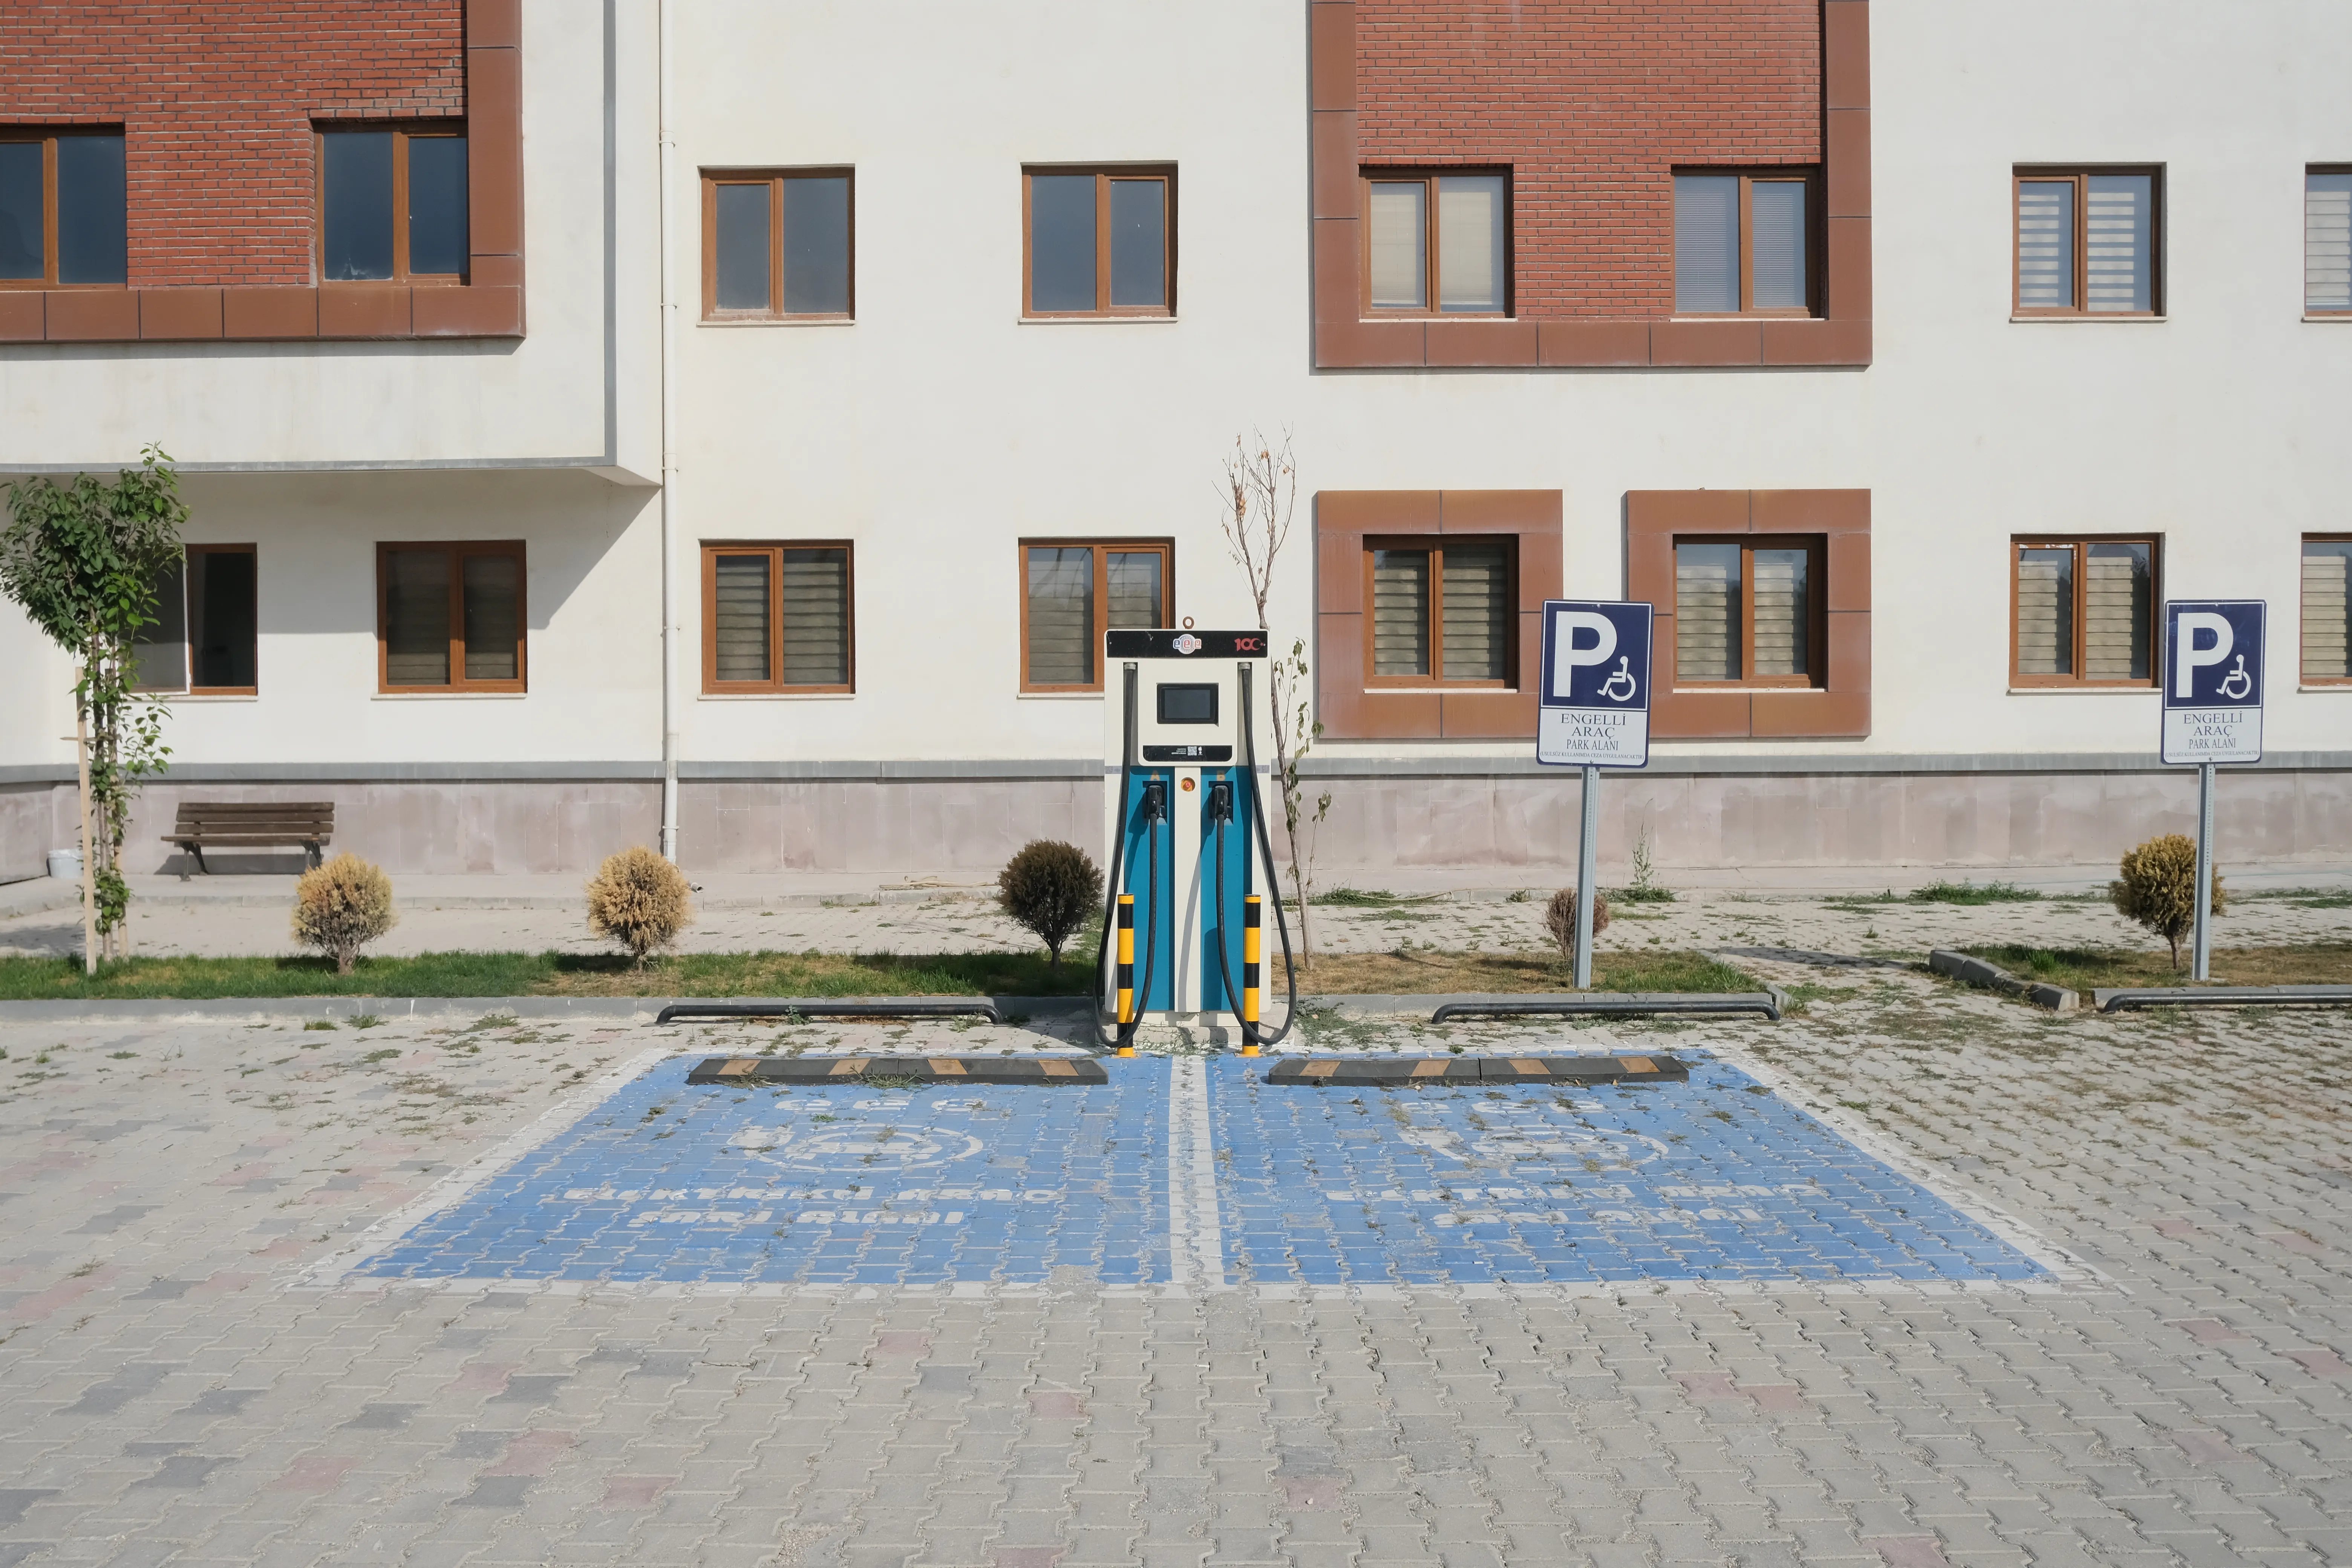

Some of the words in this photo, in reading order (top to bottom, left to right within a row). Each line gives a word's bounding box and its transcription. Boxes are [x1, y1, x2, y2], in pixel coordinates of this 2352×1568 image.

[1553, 611, 1617, 697] P
[2176, 612, 2234, 698] P
[1561, 713, 1626, 726] ENGELLİ
[2184, 710, 2243, 724] ENGELLİ
[1572, 726, 1615, 740] ARAÇ
[2194, 725, 2233, 738] ARAÇ
[1566, 739, 1588, 750] PARK
[1592, 740, 1618, 751] ALANI
[2189, 739, 2209, 749] PARK
[2212, 738, 2236, 748] ALANI
[1150, 770, 1160, 781] A
[1217, 770, 1226, 781] B
